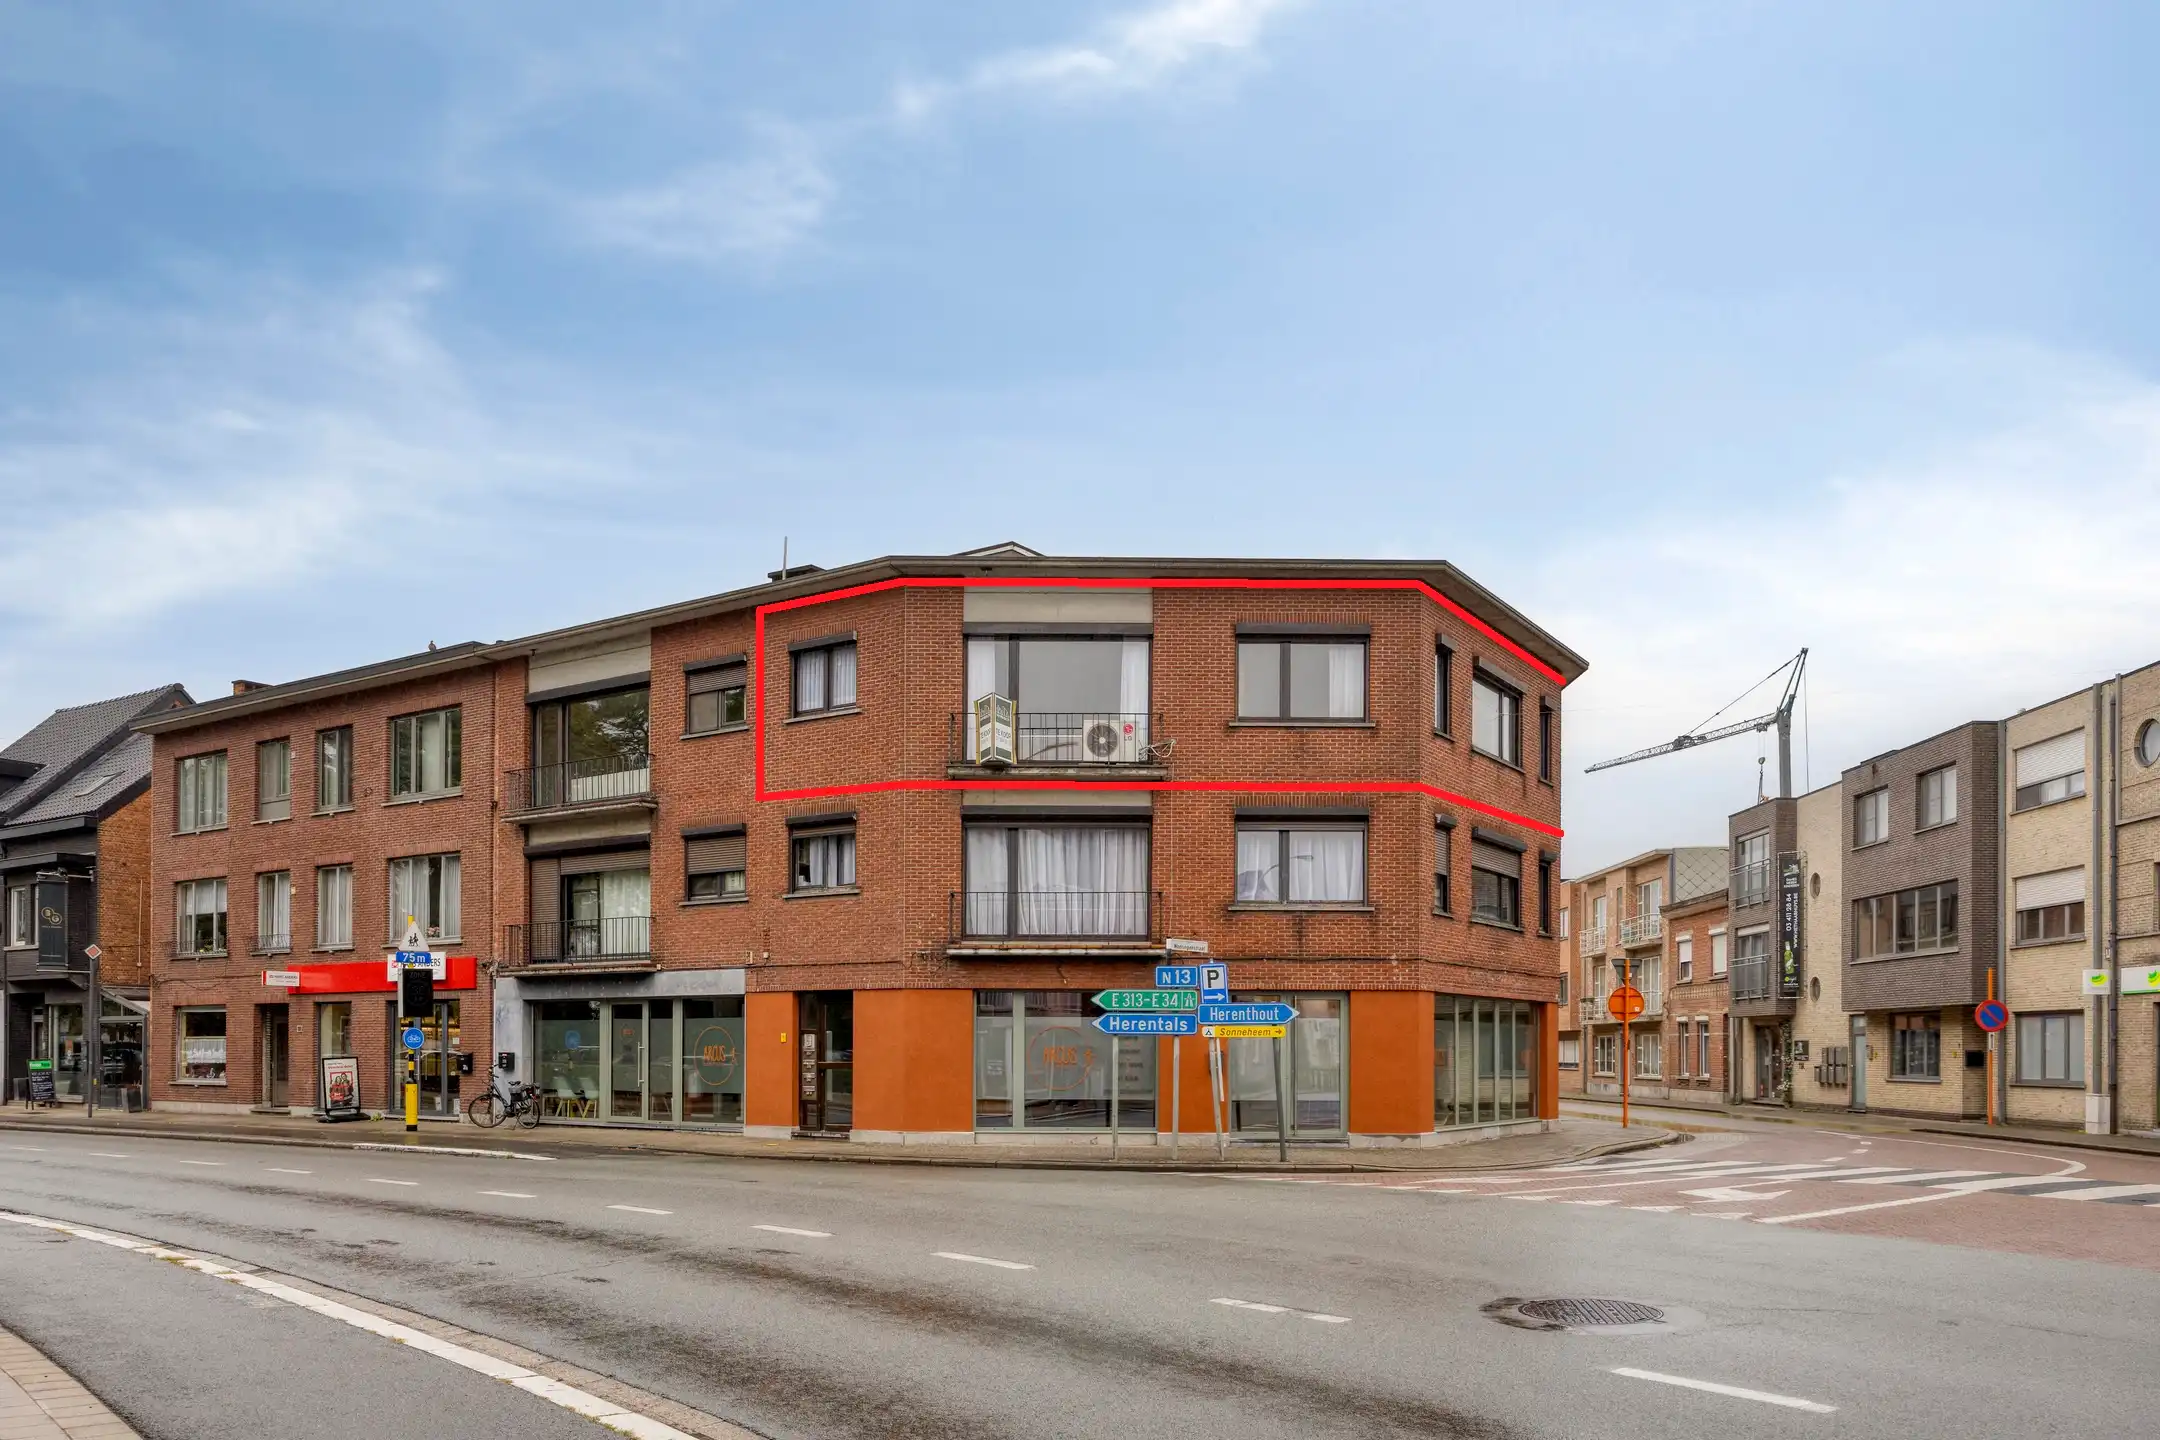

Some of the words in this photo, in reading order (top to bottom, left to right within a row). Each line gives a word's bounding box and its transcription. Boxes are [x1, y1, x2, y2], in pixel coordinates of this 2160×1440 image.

[1785, 922, 1792, 932] 03
[1162, 971, 1171, 984] N
[1174, 969, 1191, 984] 13
[1206, 969, 1220, 989] P
[1209, 1006, 1280, 1021] Herenthout
[1109, 1016, 1189, 1032] Herentals
[1219, 1028, 1271, 1037] Sonneheem
